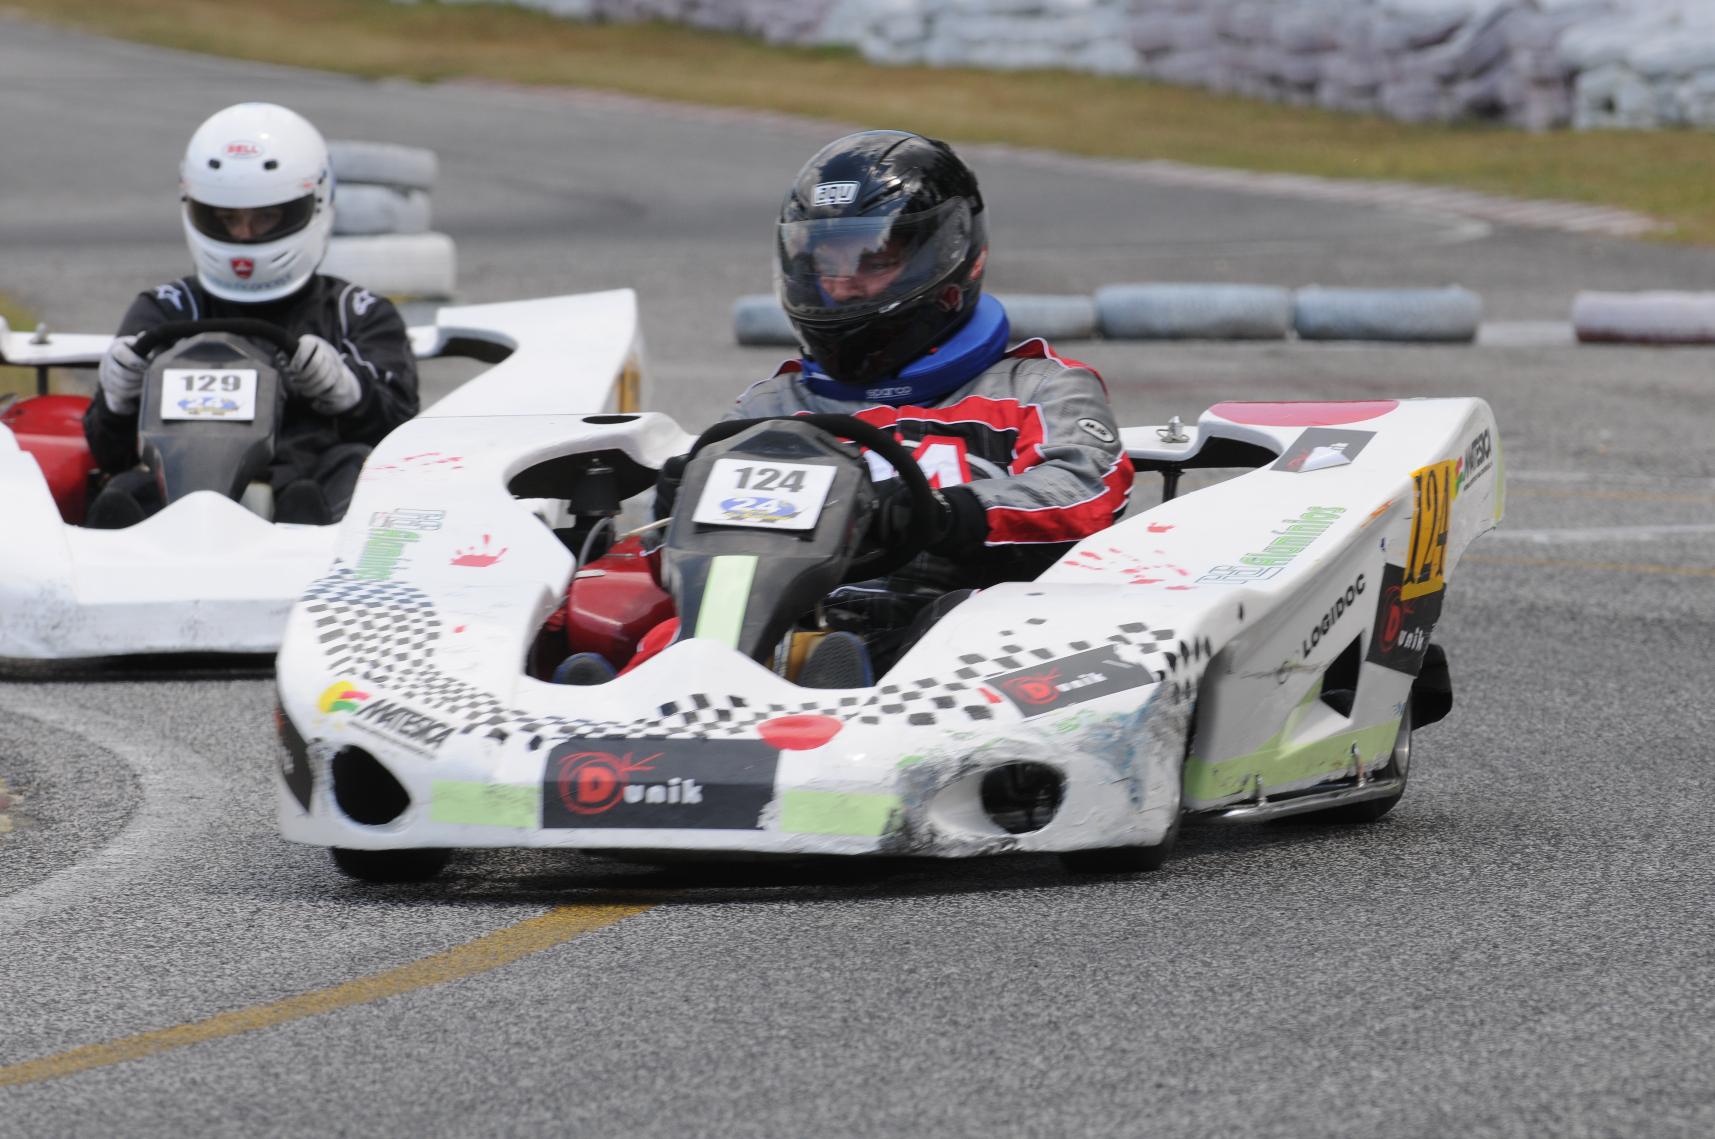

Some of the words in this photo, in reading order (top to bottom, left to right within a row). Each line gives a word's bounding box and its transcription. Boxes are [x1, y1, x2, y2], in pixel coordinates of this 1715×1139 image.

[227, 144, 258, 154] BELL
[181, 375, 241, 392] 129
[734, 466, 807, 493] 124
[1404, 467, 1448, 584] 124
[1302, 573, 1366, 659] LOGIDOC
